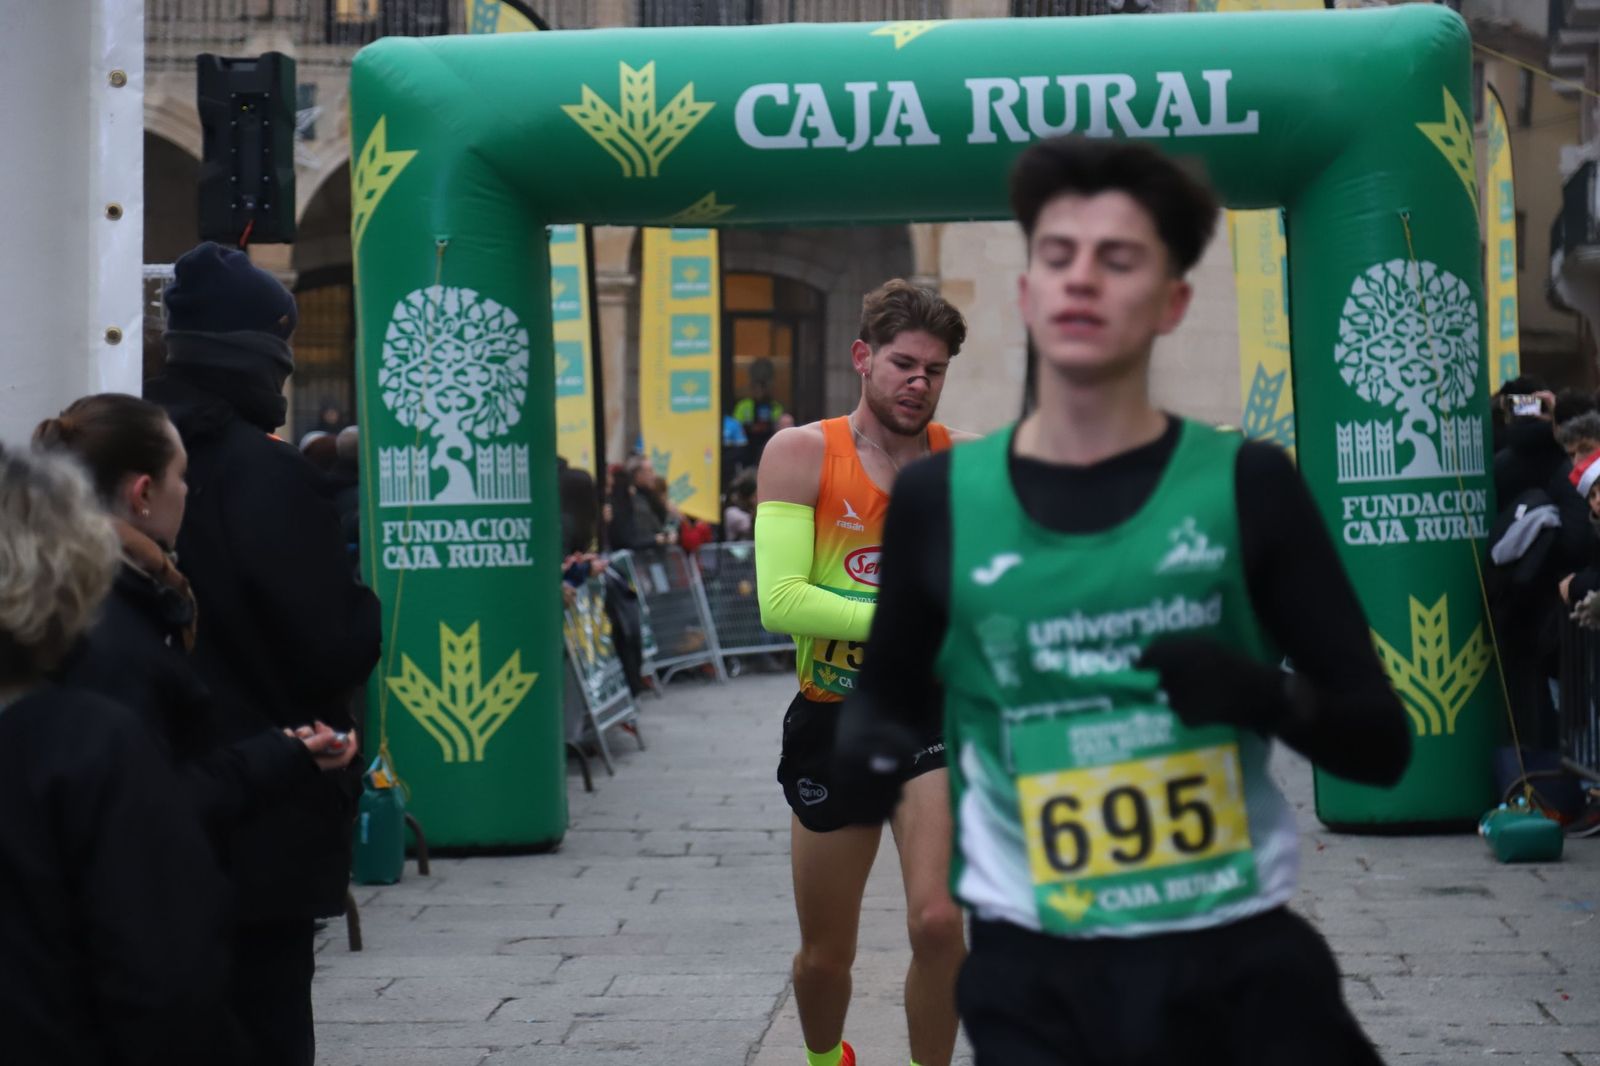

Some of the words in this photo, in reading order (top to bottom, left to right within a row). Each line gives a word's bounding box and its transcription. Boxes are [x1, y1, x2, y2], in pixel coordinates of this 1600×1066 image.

[734, 81, 940, 151] CAJA
[965, 69, 1259, 144] RURAL
[1342, 489, 1487, 520] FUNDACION
[382, 518, 532, 544] FUNDACION
[836, 519, 865, 532] rasan
[1343, 519, 1410, 545] CAJA
[1415, 514, 1489, 542] RURAL
[382, 545, 442, 570] CAJA
[447, 543, 534, 568] RURAL
[1028, 592, 1223, 646] universidad
[1041, 775, 1216, 874] 695
[1099, 882, 1162, 911] CAJA
